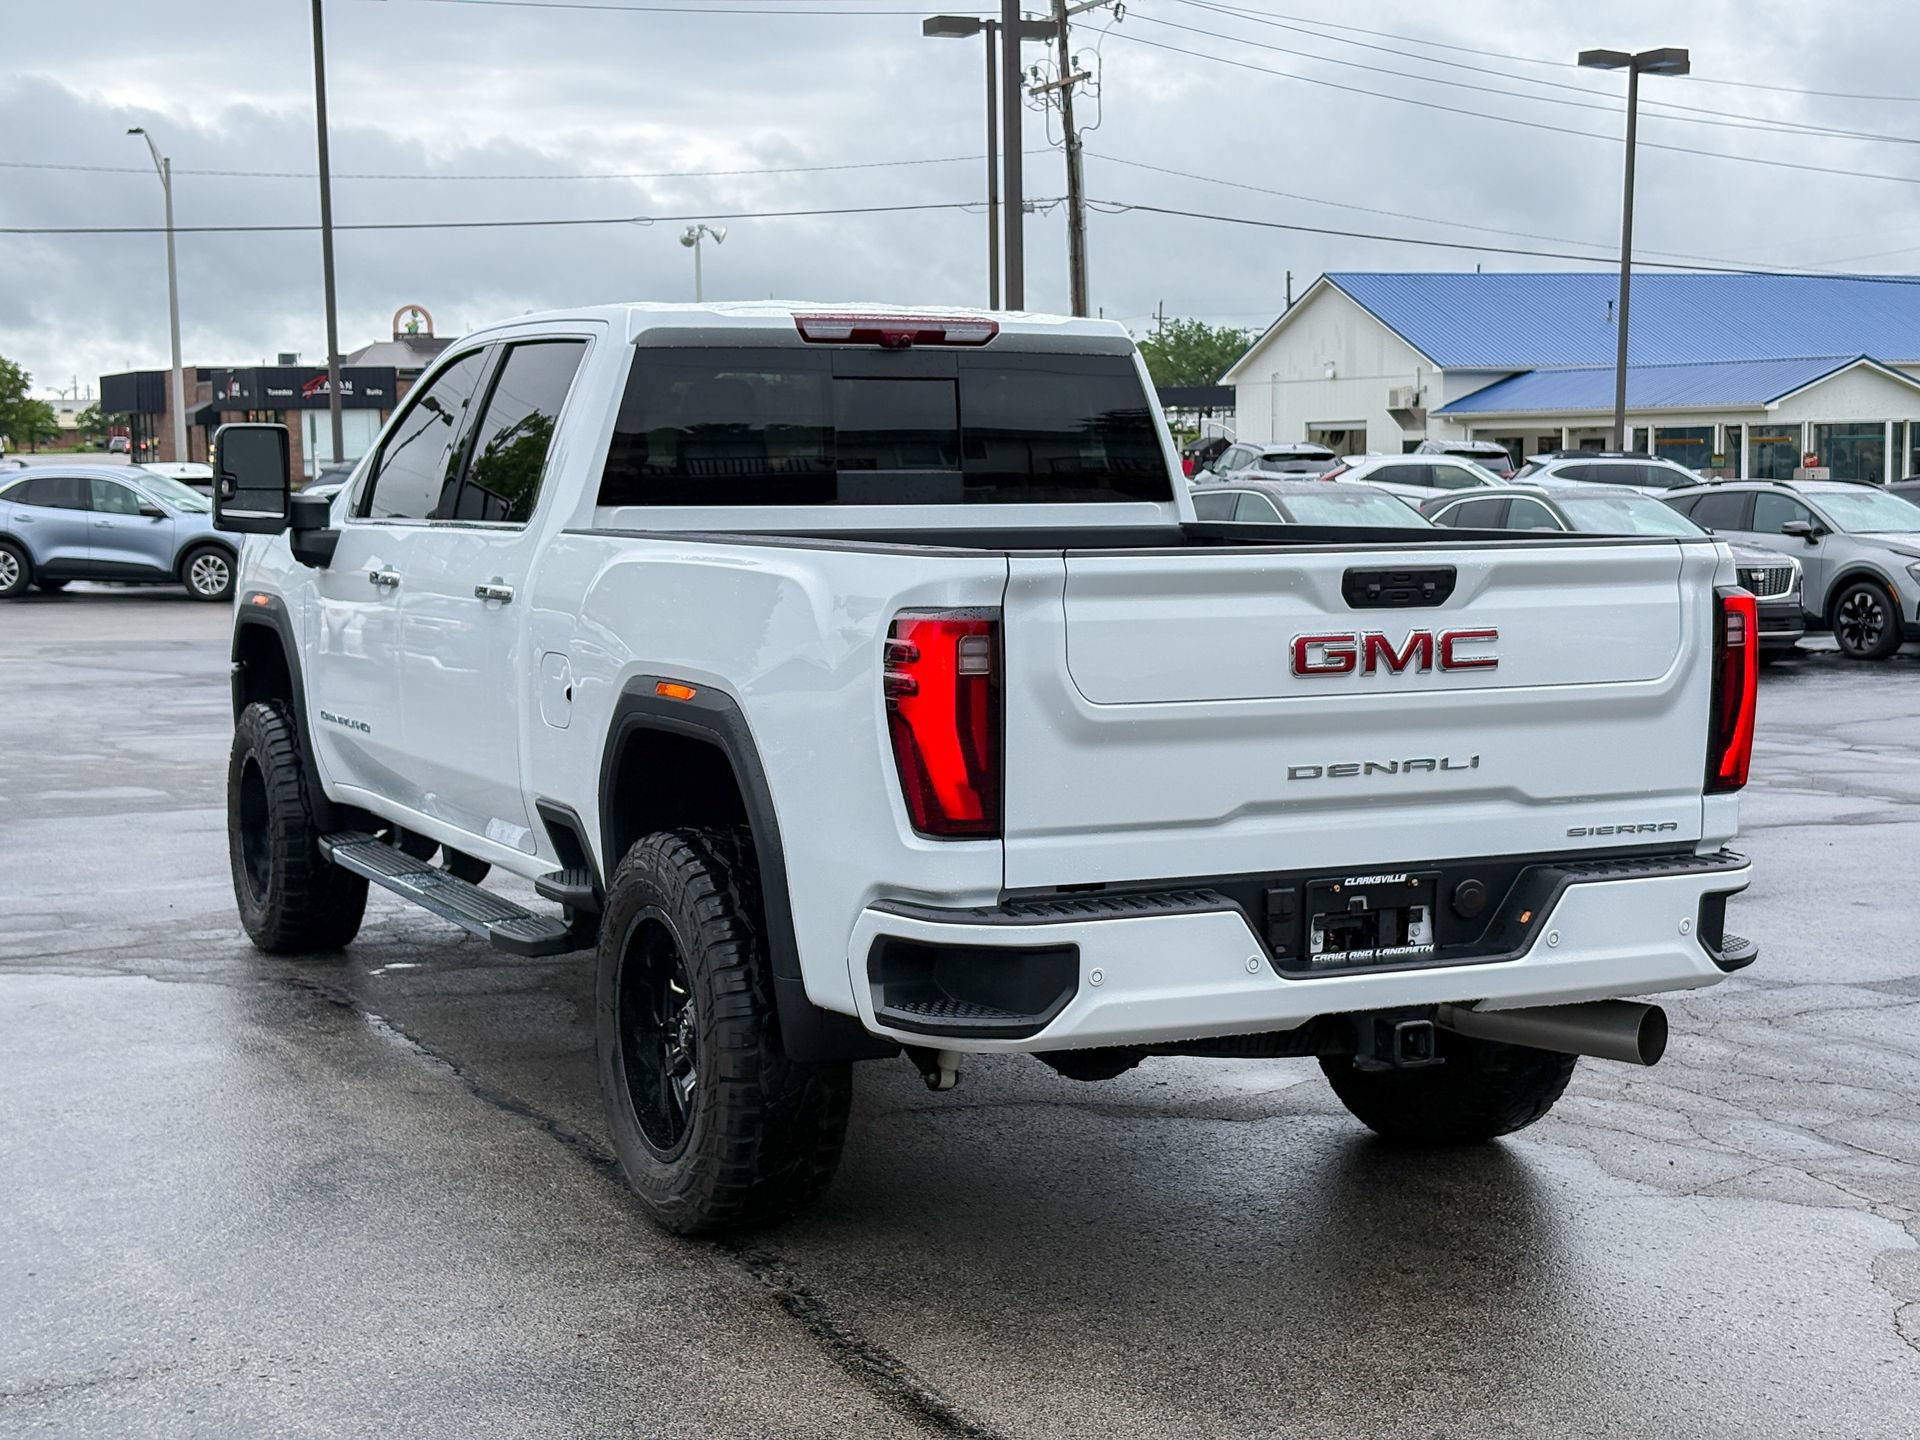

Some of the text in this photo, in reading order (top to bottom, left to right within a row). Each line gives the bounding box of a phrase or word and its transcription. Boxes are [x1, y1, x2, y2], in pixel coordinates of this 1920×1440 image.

[1289, 626, 1499, 679] GMC
[1287, 753, 1480, 781] DENALI
[1566, 821, 1678, 838] SIERRA
[1344, 873, 1407, 886] CLARKSVILLE
[1312, 943, 1435, 961] CRAIG AND LANDRETH
